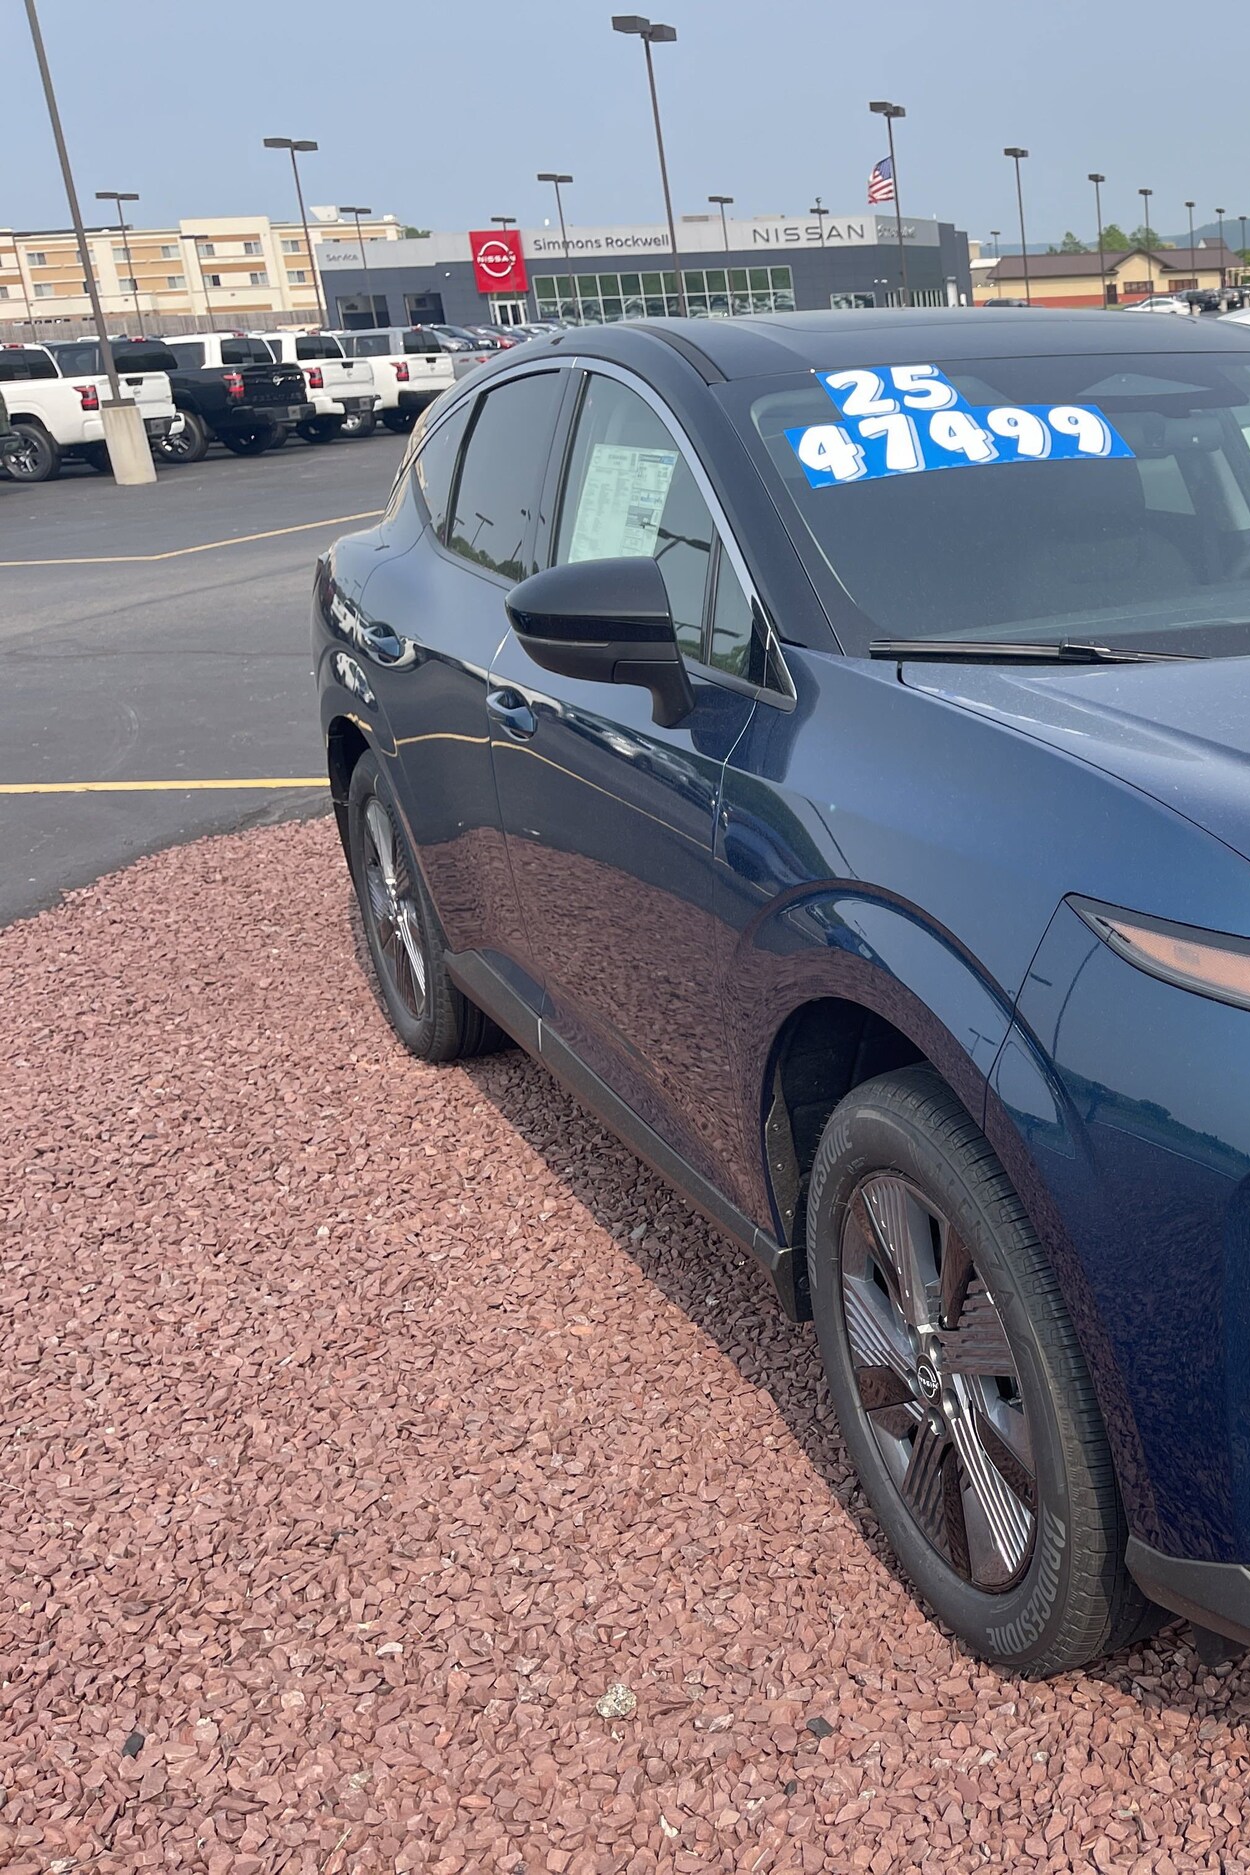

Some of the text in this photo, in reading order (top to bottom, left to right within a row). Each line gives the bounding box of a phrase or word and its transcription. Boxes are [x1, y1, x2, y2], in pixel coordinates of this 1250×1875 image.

[477, 254, 516, 264] NISSAN
[533, 234, 669, 251] Simmons Rockwell
[753, 224, 864, 244] NISSAN
[825, 365, 957, 416] 25
[798, 406, 1112, 481] 47499
[807, 1122, 853, 1289] BRIDGESTONE
[985, 1501, 1066, 1656] BRIDGESTONE
